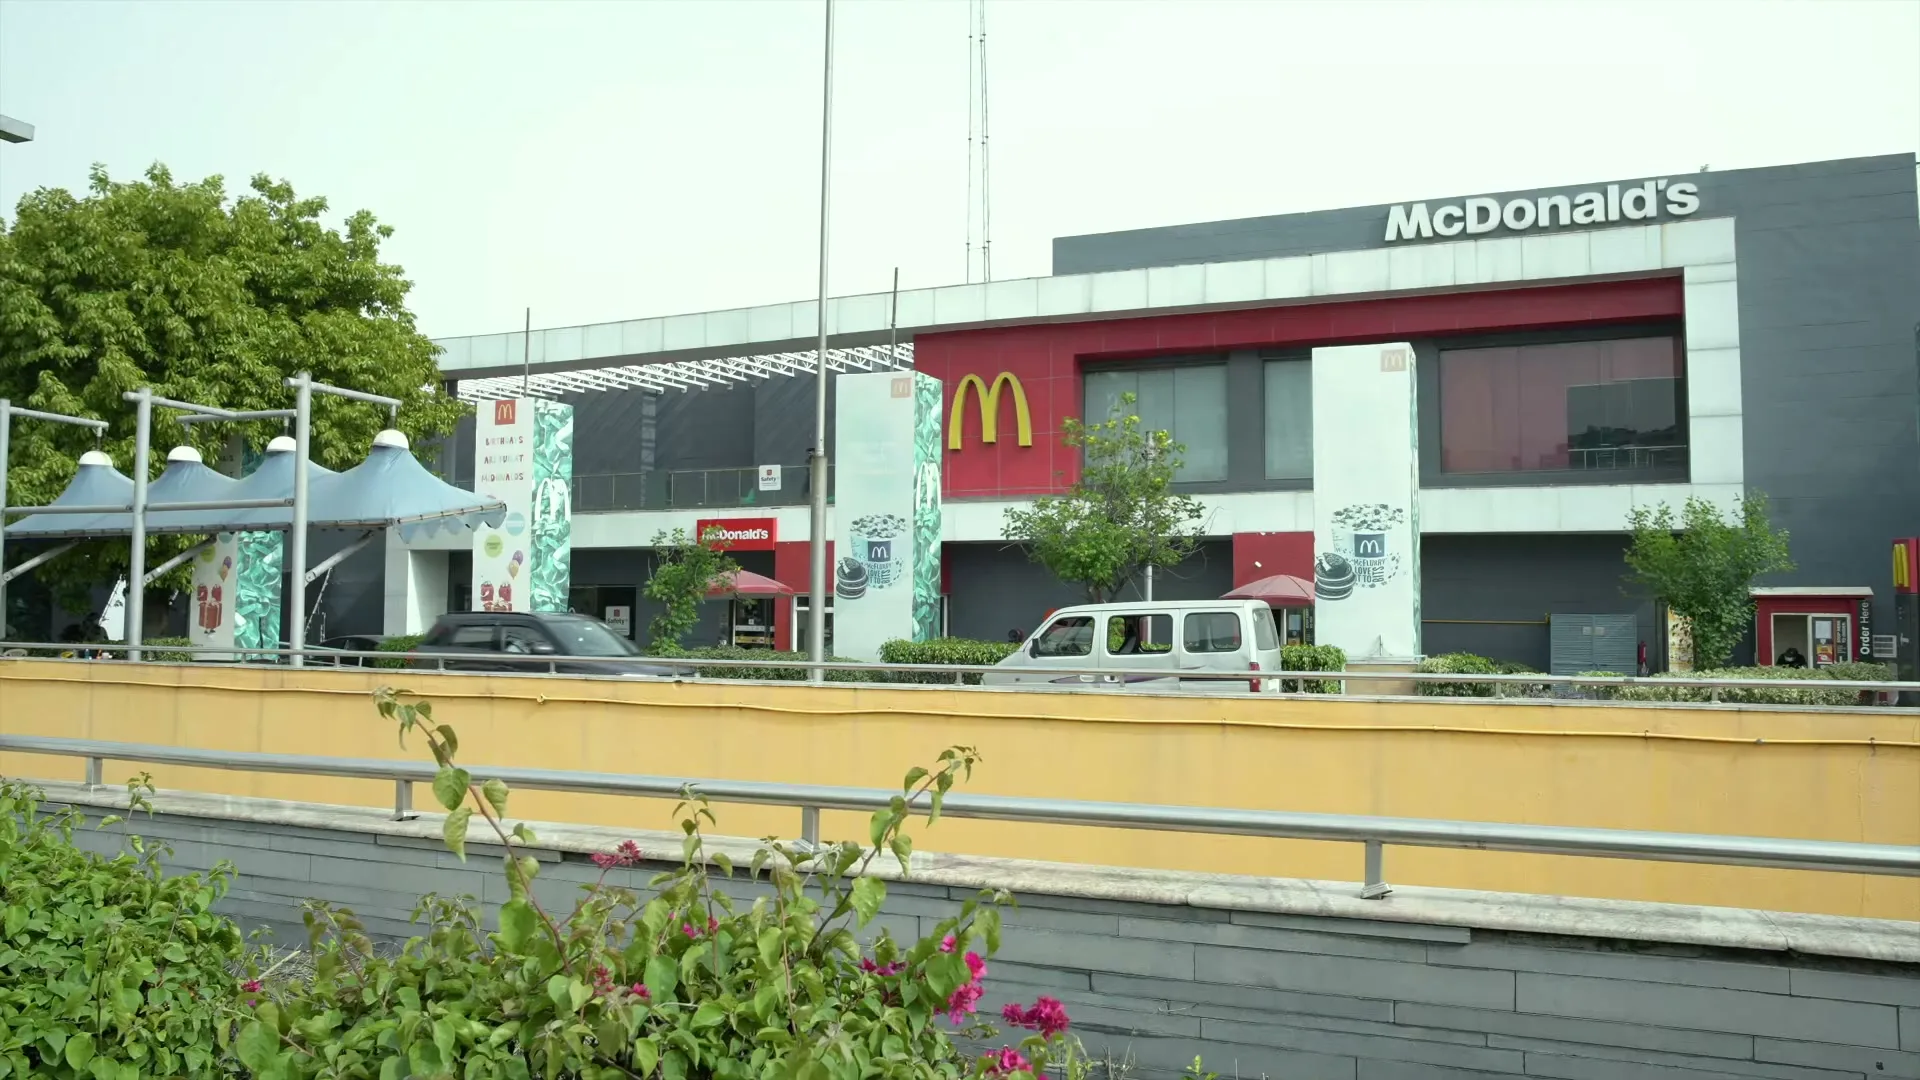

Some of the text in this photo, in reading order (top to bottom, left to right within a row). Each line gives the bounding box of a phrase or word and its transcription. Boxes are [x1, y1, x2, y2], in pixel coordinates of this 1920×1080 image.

[1385, 179, 1700, 241] McDonald's
[881, 569, 891, 584] BITS
[1355, 566, 1371, 575] LOVE
[1363, 574, 1372, 583] TO
[1372, 566, 1384, 583] BITS
[1860, 601, 1870, 655] Order Here
